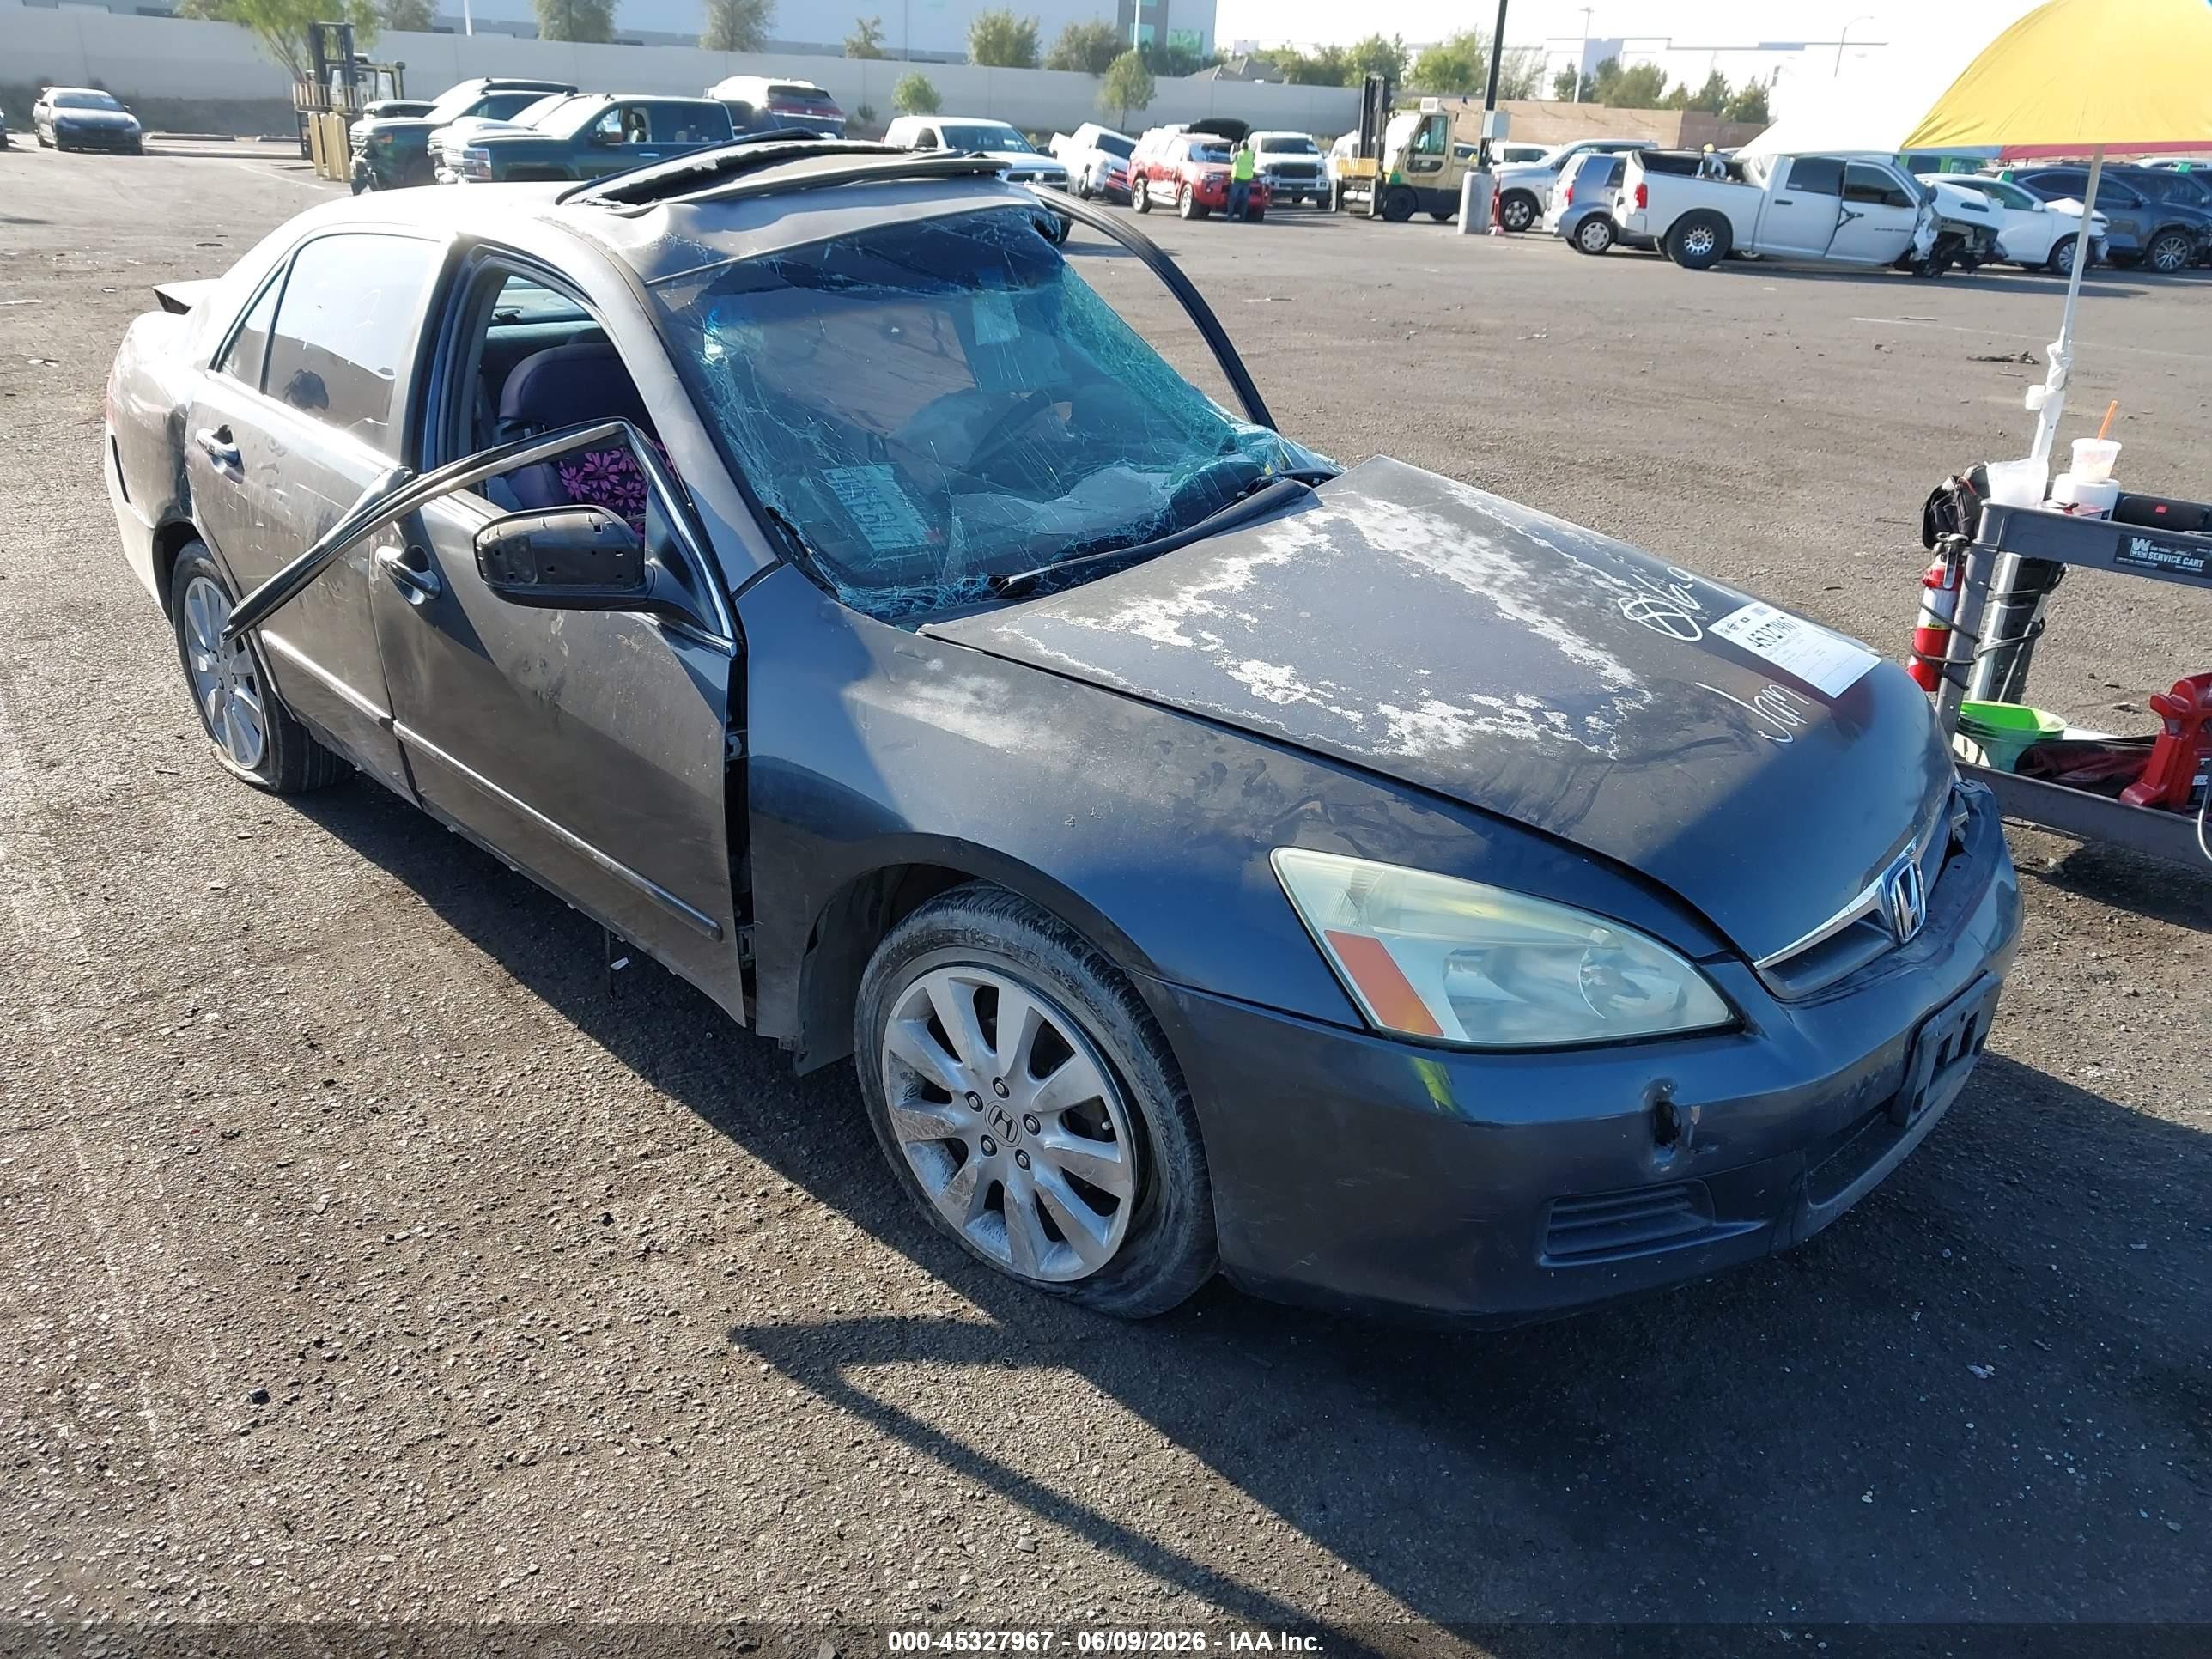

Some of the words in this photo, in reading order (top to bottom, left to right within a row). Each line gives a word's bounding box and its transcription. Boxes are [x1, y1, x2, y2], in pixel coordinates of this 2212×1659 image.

[2148, 551, 2182, 564] SERVICE
[2183, 557, 2205, 568] CART
[1746, 616, 1802, 649] 45327967
